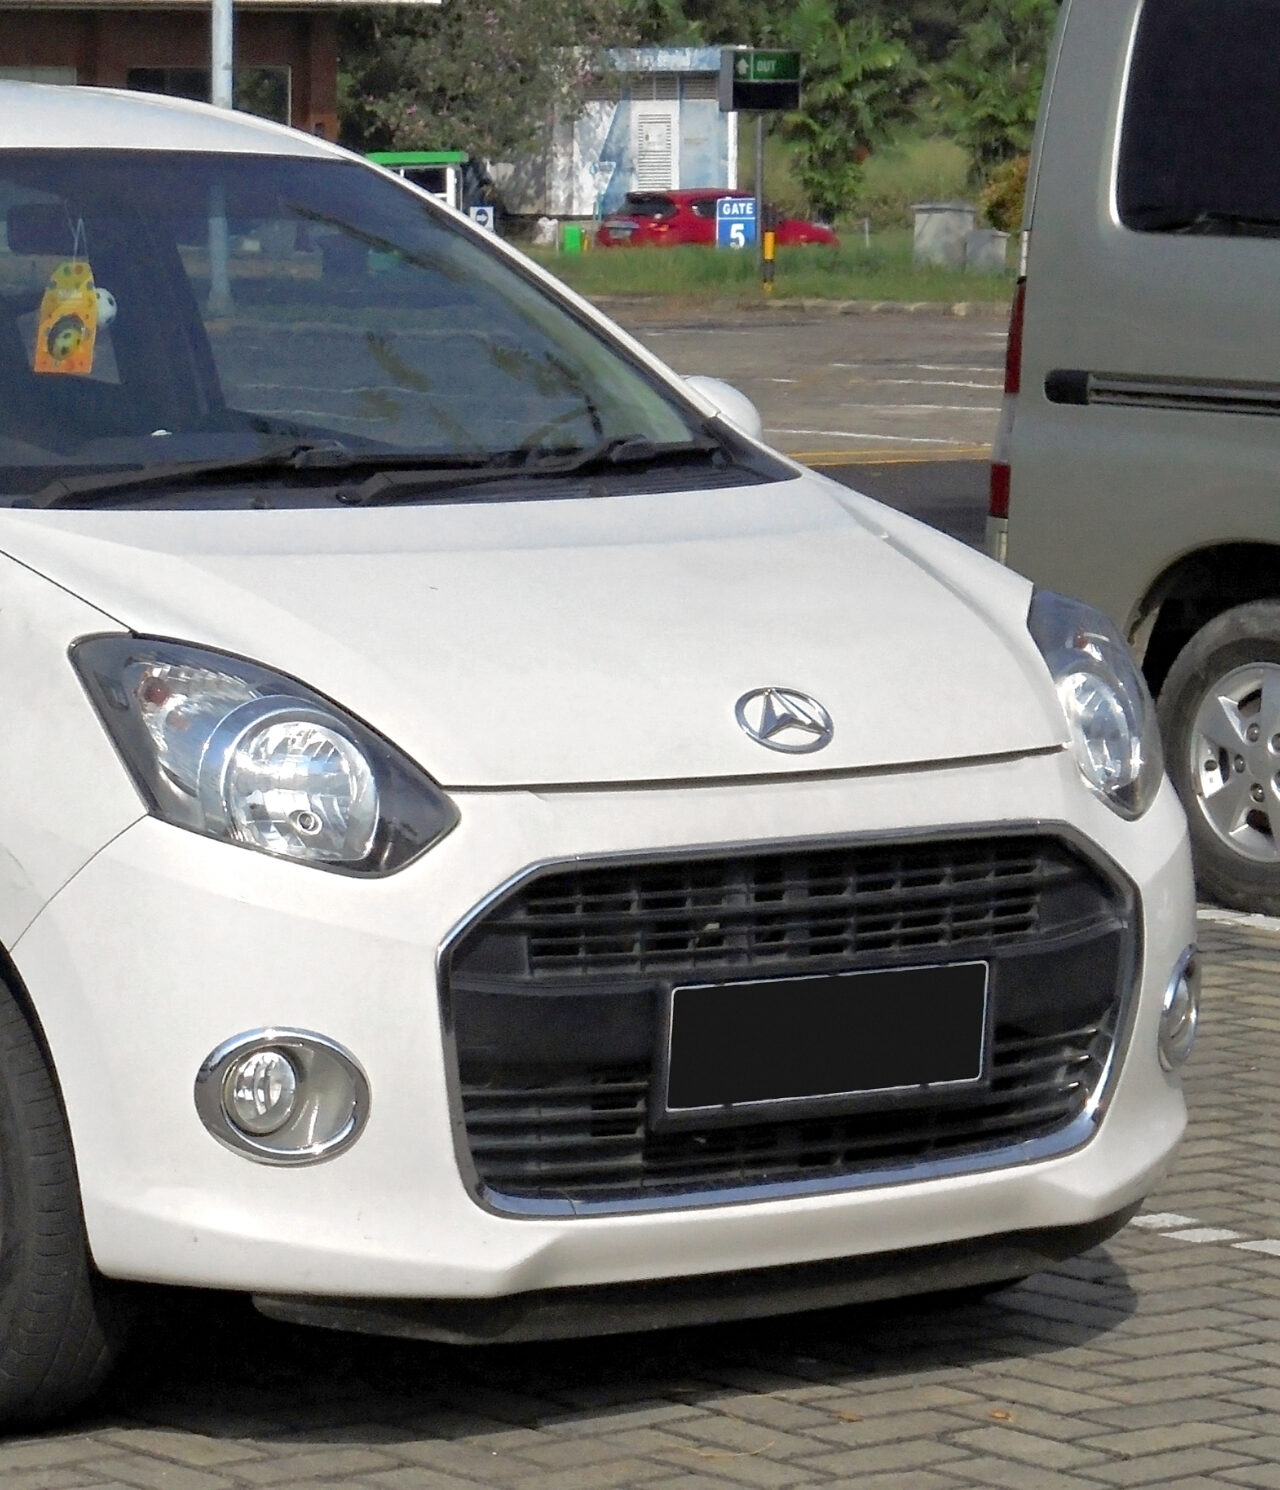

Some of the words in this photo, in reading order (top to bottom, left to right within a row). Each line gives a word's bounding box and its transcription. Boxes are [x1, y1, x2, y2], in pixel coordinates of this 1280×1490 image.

[756, 60, 777, 73] OUT
[722, 203, 754, 215] GATE
[730, 223, 745, 248] 5
